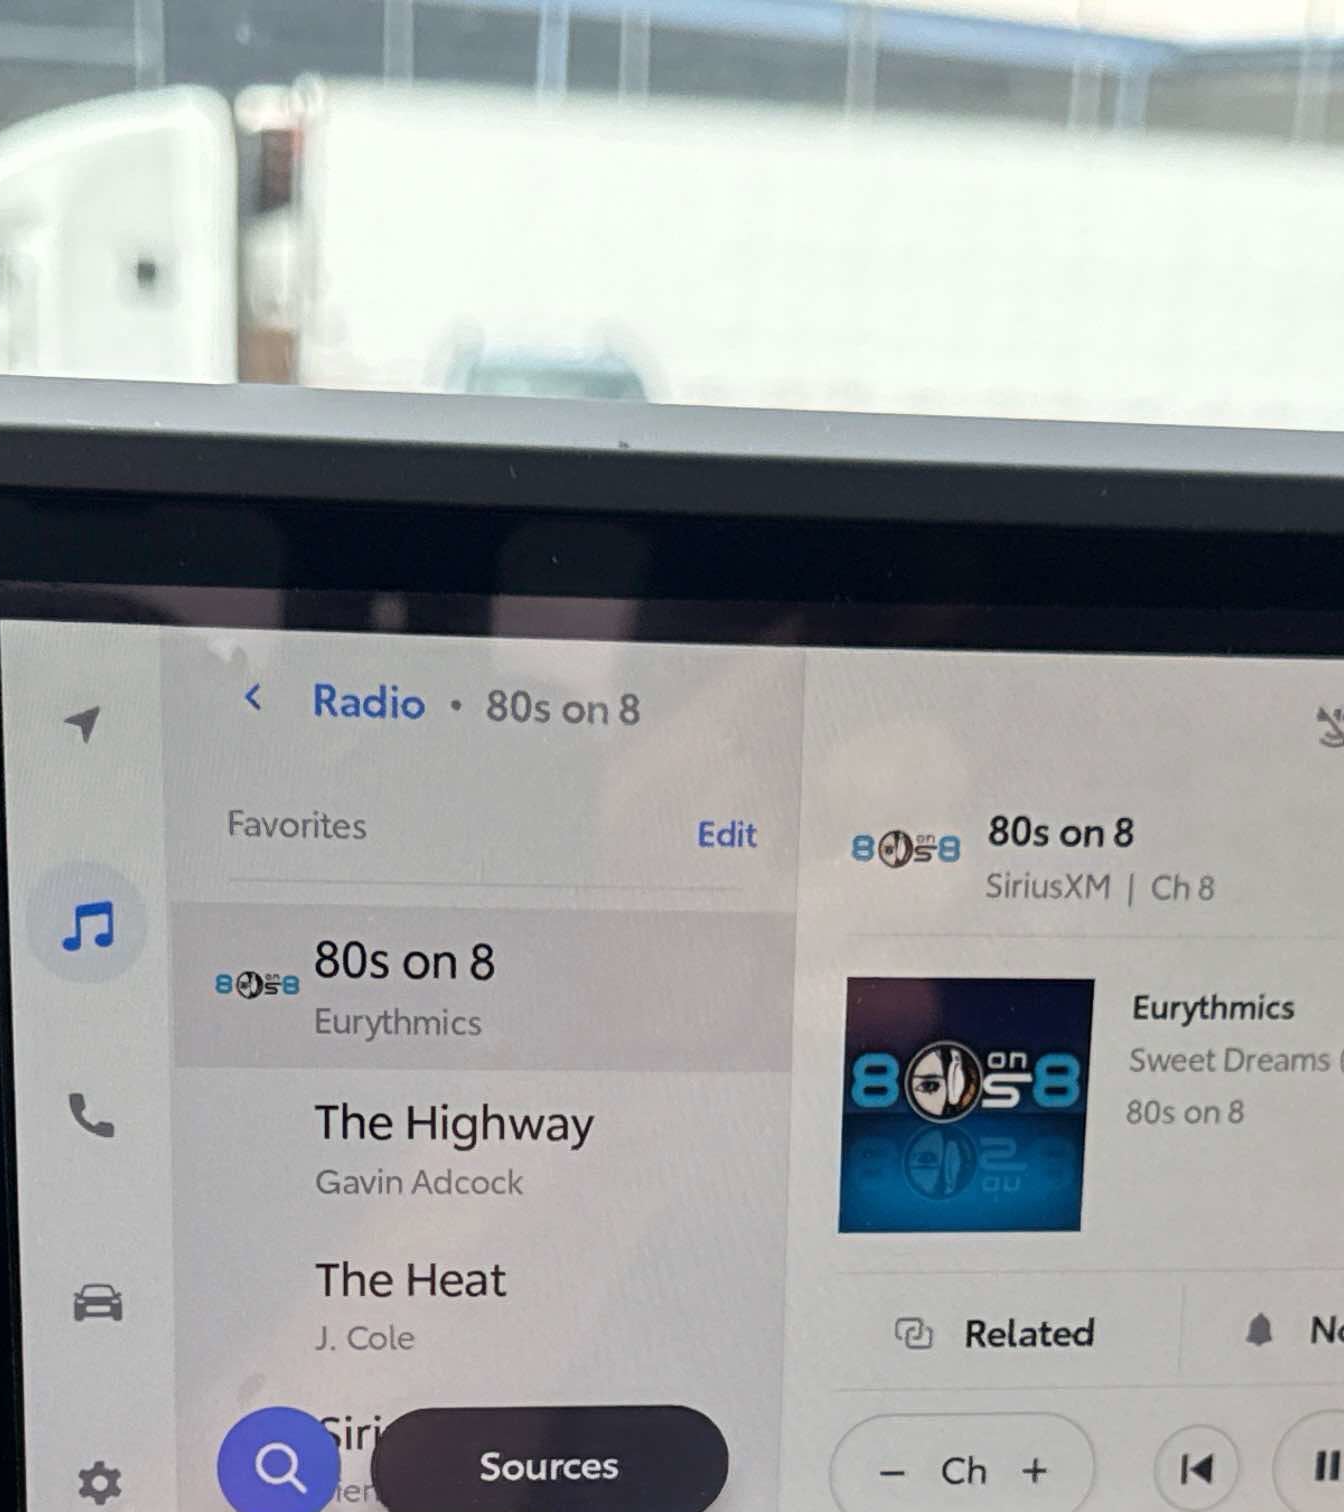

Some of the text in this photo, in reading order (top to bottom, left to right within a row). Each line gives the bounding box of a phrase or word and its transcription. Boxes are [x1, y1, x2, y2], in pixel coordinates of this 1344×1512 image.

[312, 683, 642, 727] Radio 80s on 8
[228, 809, 368, 842] Favorites
[698, 820, 759, 850] Edit
[988, 816, 1136, 848] 80s on 8
[986, 871, 1217, 902] SiriusXM Ch 8
[314, 940, 496, 982] 80s on 8
[315, 1007, 483, 1043] Eurythmics
[1133, 995, 1296, 1028] Eurythmics
[1128, 1045, 1216, 1073] Sweet
[1224, 1045, 1331, 1073] Dreams
[314, 1102, 595, 1152] The Highway
[1126, 1099, 1246, 1127] 80s on 8
[314, 1168, 524, 1198] Gavin Adcock
[315, 1261, 507, 1299] The Heat
[313, 1324, 415, 1354] J. Cole
[966, 1317, 1096, 1350] Related
[479, 1451, 620, 1482] Sources
[941, 1455, 988, 1487] Ch
